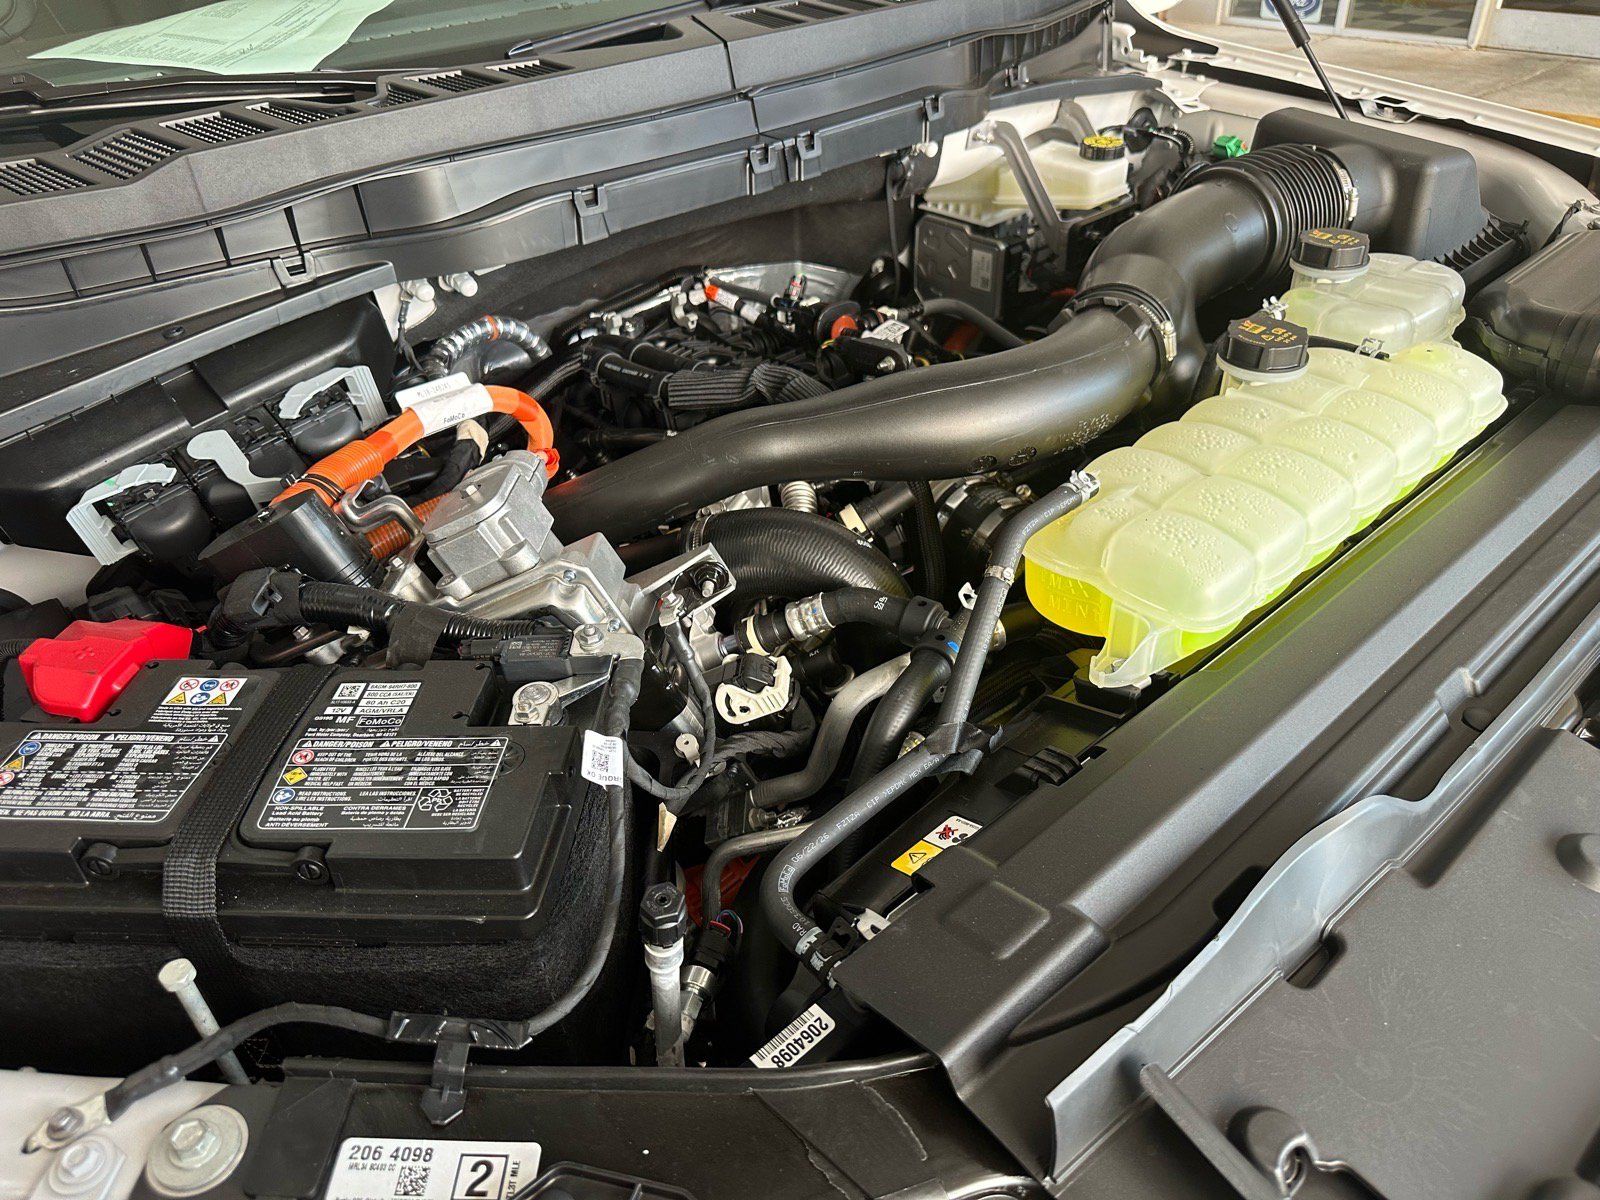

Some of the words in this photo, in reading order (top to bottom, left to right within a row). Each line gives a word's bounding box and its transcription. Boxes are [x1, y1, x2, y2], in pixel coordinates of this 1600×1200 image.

[335, 716, 356, 724] MF
[359, 717, 402, 726] FoMoCo
[41, 733, 100, 741] DANGER/POISON
[115, 734, 175, 742] PELIGRO/VENENO
[313, 740, 375, 748] DANGER/POISON
[792, 922, 807, 937] RAD
[771, 1016, 829, 1068] 2064098
[348, 1145, 383, 1161] 206
[389, 1146, 434, 1162] 4098
[464, 1159, 494, 1197] 2
